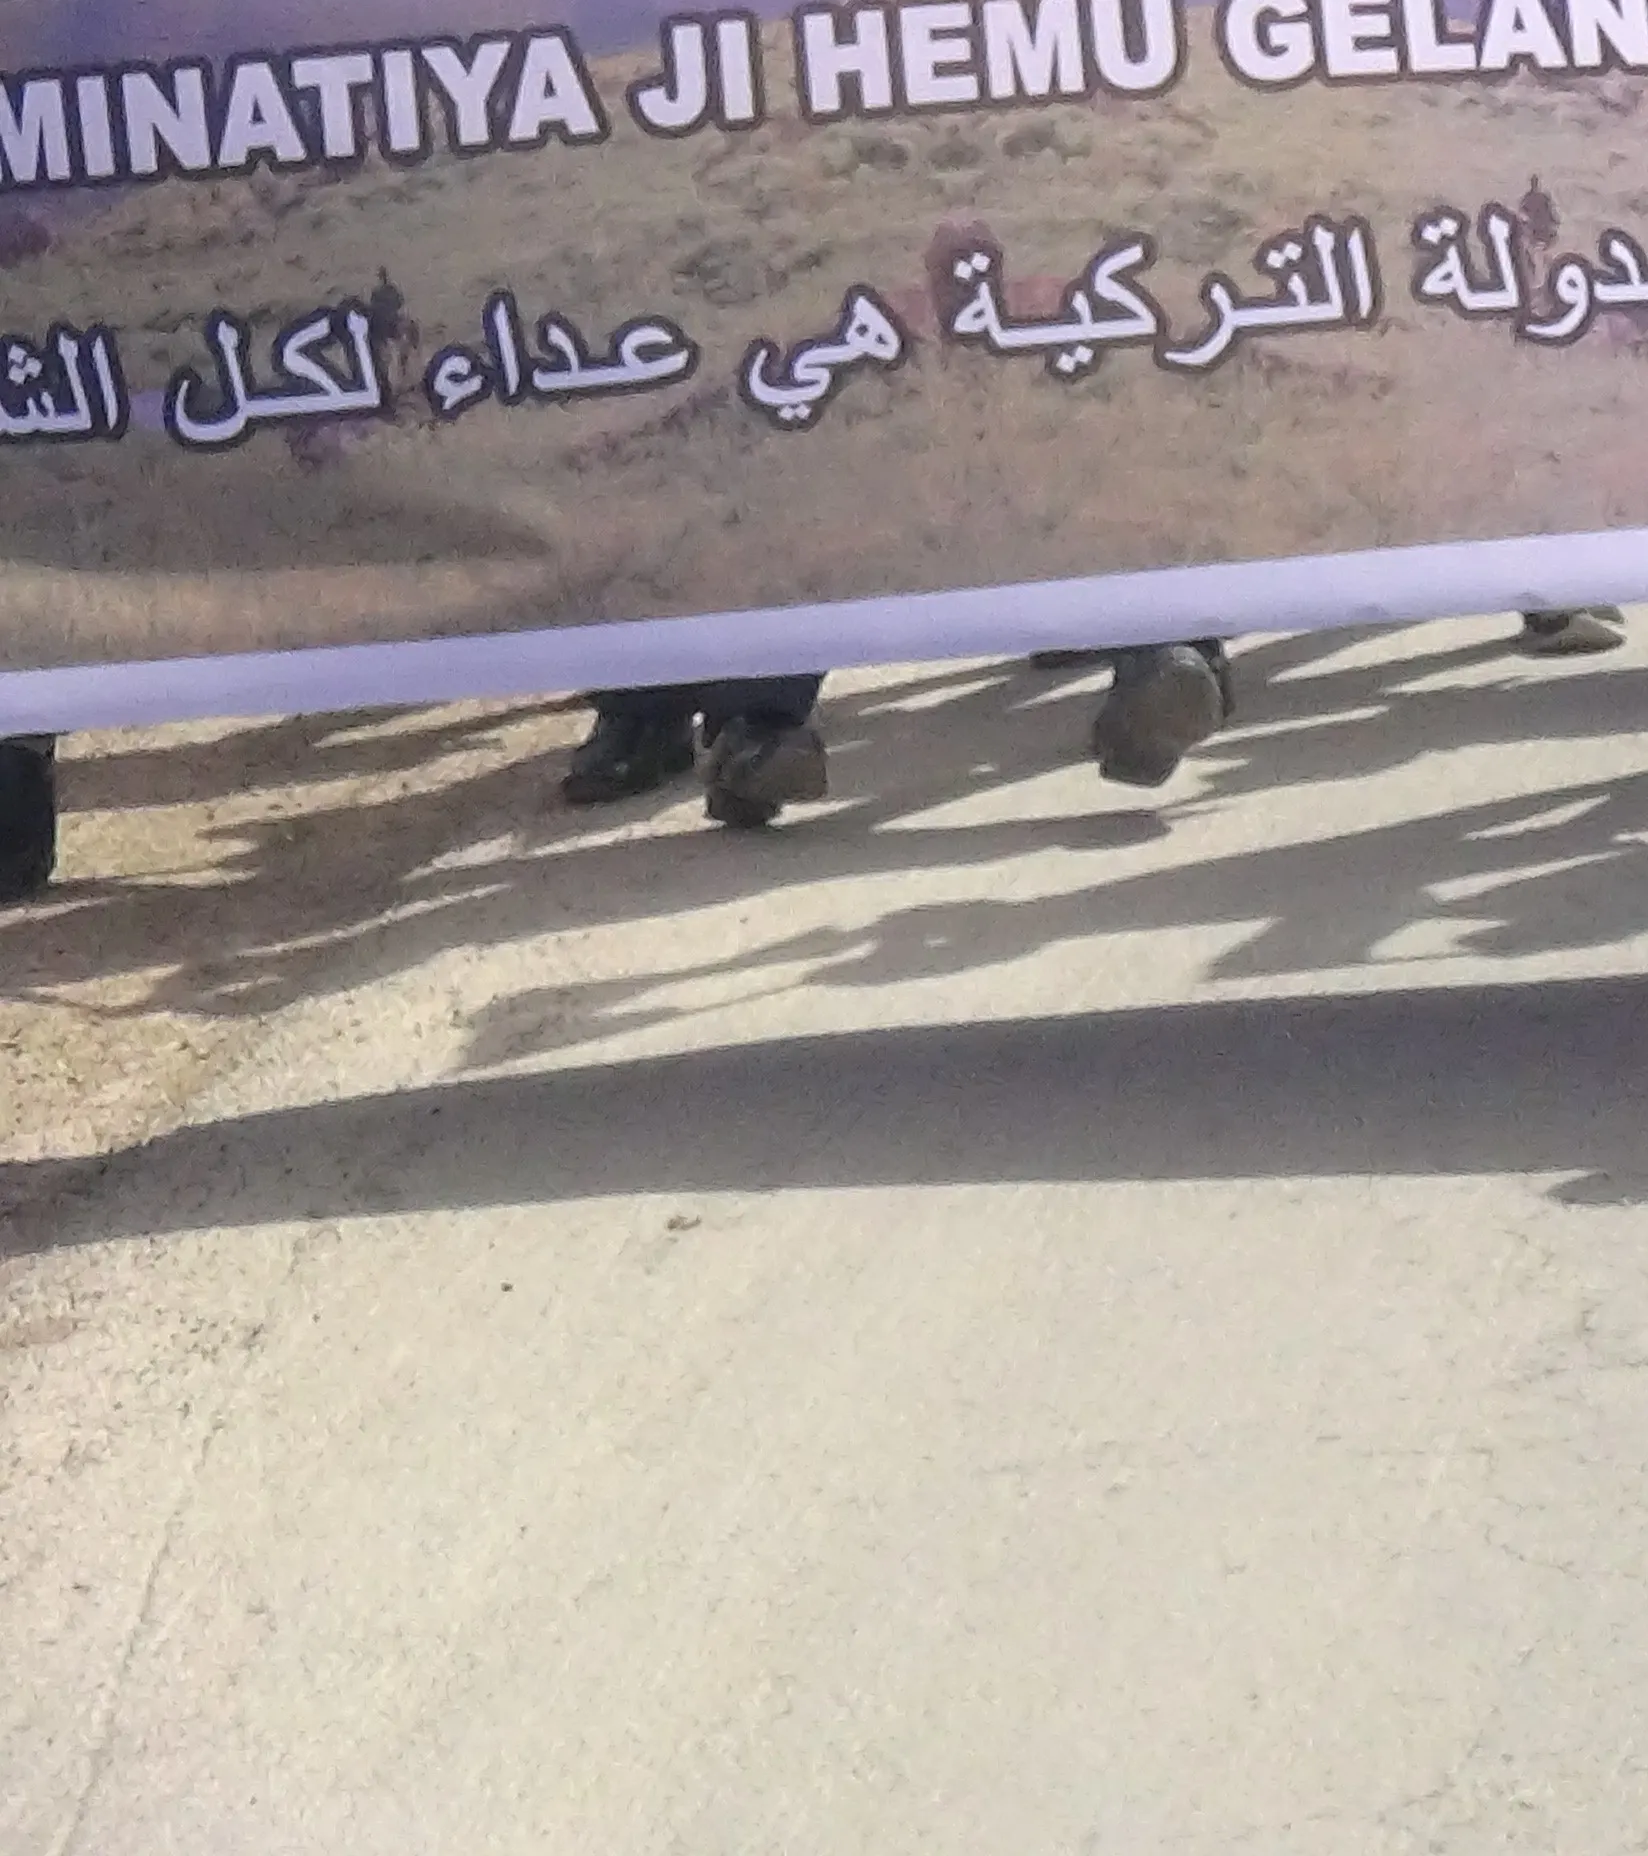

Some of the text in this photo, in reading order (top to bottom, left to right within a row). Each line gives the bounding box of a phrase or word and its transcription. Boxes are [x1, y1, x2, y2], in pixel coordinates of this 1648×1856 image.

[0, 35, 597, 184] MINATIYA
[636, 20, 754, 129] JI
[429, 296, 693, 415] عداء
[742, 288, 904, 424] هي
[950, 216, 1378, 372] التركية
[168, 309, 389, 446] لكل
